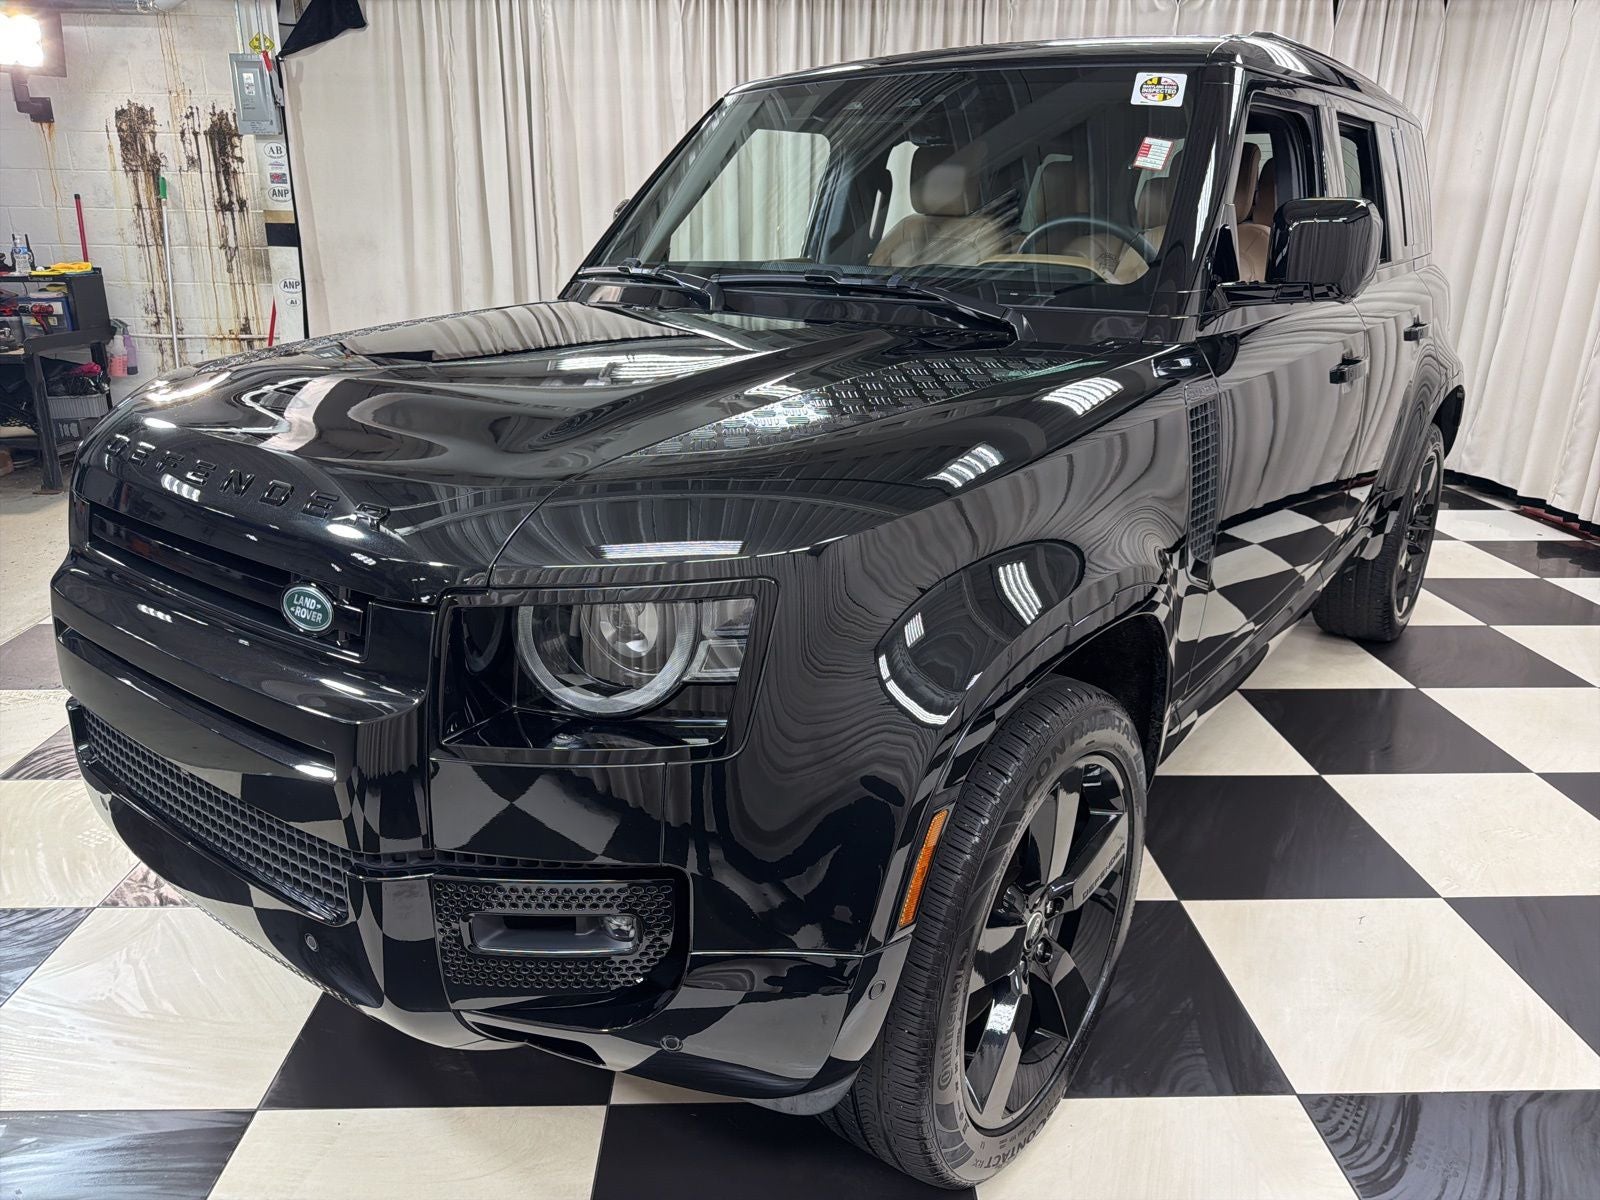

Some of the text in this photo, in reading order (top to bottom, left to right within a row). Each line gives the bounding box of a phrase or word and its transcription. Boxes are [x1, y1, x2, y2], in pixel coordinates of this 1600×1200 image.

[268, 145, 283, 155] AB
[271, 188, 290, 198] ANP
[283, 280, 301, 290] ANP
[104, 431, 391, 528] DEFENDER
[293, 593, 316, 610] LAND
[294, 605, 323, 624] ROVER
[1082, 841, 1126, 901] DEFENDER
[937, 968, 965, 1091] Continental
